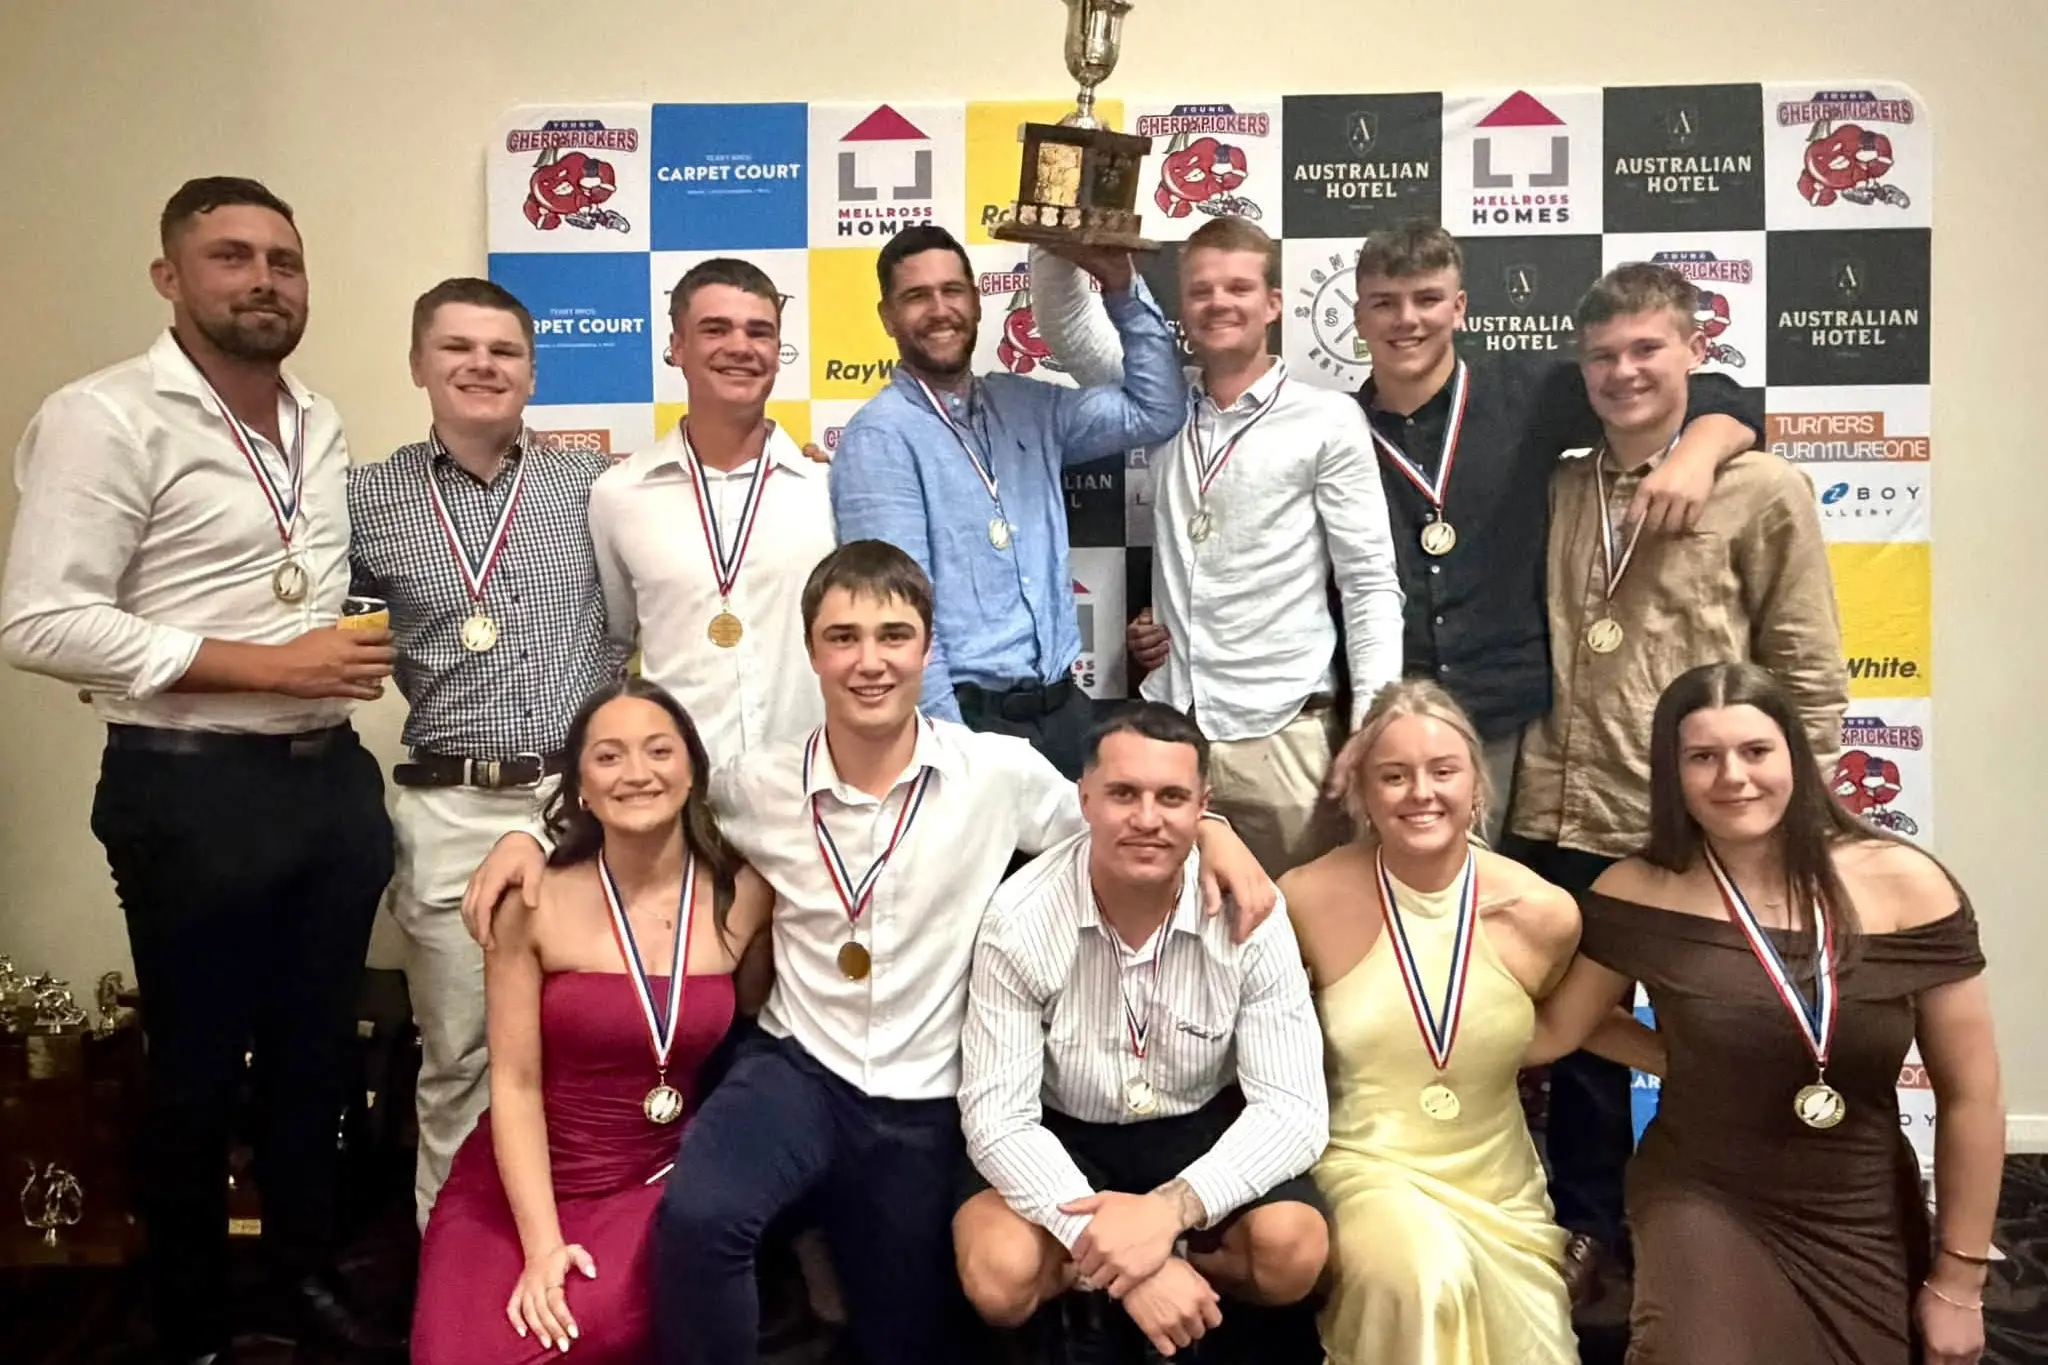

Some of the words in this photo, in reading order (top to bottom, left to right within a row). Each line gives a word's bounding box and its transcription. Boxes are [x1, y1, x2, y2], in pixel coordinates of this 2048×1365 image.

[1138, 115, 1269, 137] CHERRYPICKERS
[508, 130, 637, 152] CHERRYPICKERS
[657, 165, 731, 182] CARPET
[734, 163, 801, 180] COURT
[1293, 162, 1430, 181] AUSTRALIAN
[1614, 155, 1752, 175] AUSTRALIAN
[1325, 182, 1398, 199] HOTEL
[1647, 176, 1720, 193] HOTEL
[1472, 194, 1570, 206] MELLROSS
[837, 207, 933, 219] MELLROSS
[1471, 207, 1570, 225] HOMES
[533, 319, 575, 335] RPET
[578, 318, 645, 334] COURT
[1455, 314, 1575, 333] AUSTRALIA
[1778, 310, 1919, 328] AUSTRALIAN
[1486, 334, 1558, 351] HOTEL
[1812, 328, 1886, 347] HOTEL
[1775, 415, 1874, 435] TURNERS
[1857, 487, 1920, 501] BOY
